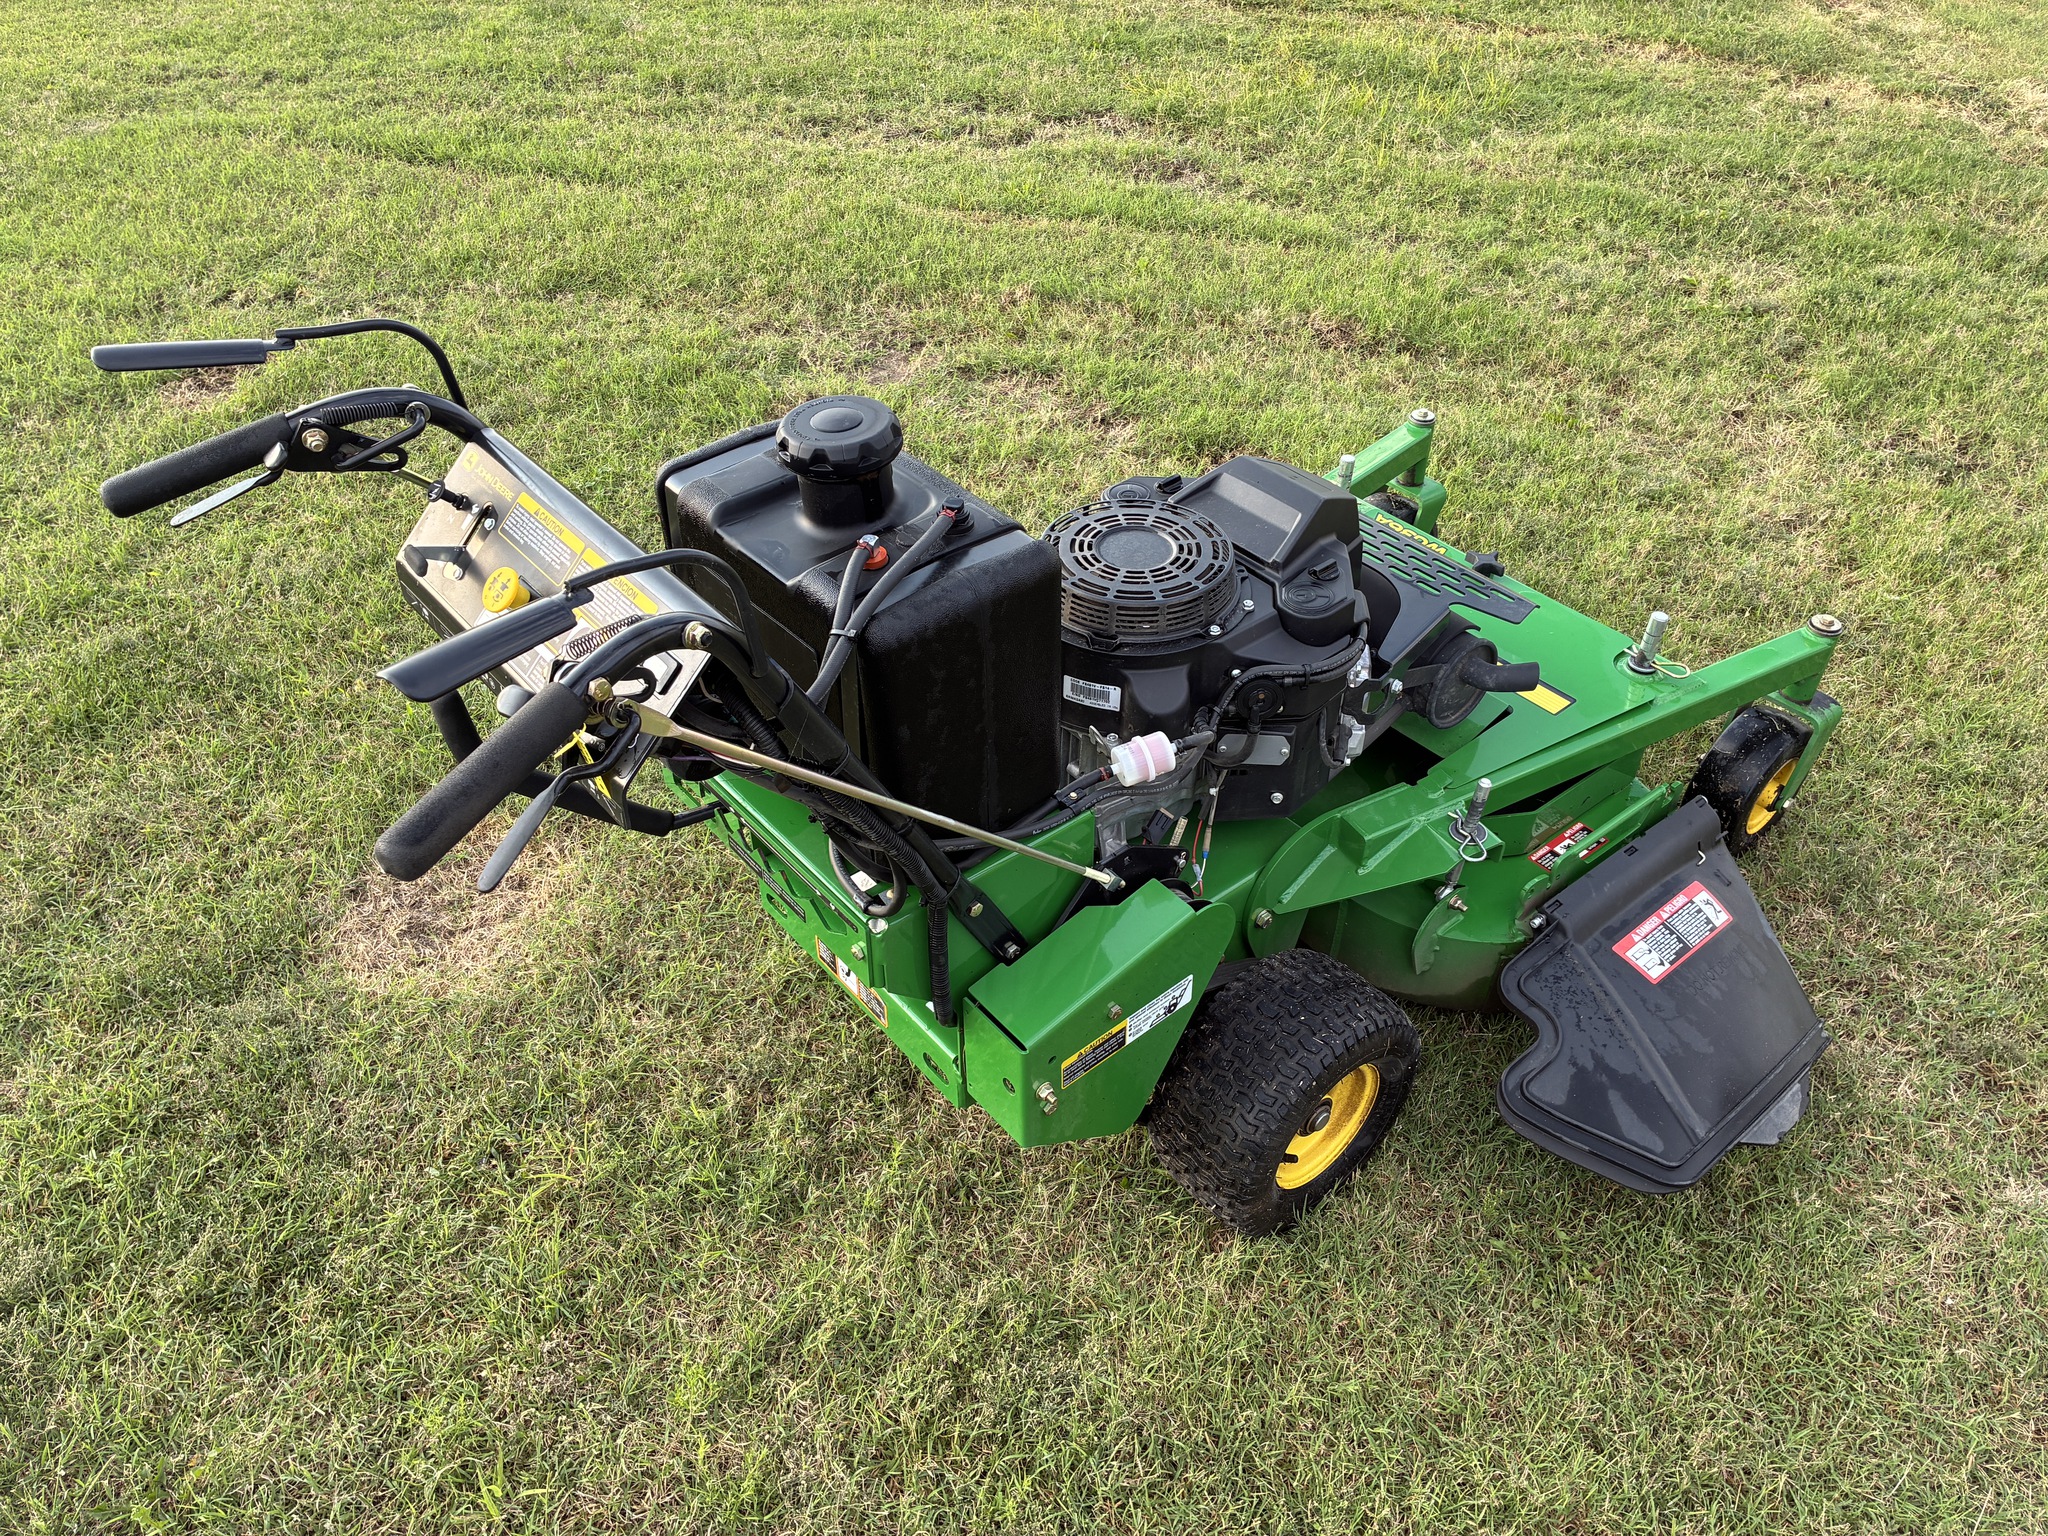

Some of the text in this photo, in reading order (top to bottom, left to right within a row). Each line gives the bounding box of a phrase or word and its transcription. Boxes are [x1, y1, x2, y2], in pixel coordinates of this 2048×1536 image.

[474, 463, 494, 483] JOHN
[491, 477, 515, 502] DEERE
[538, 511, 565, 537] CAUTION
[1635, 914, 1662, 938] DANGER
[1662, 893, 1689, 915] PELIGRO
[1084, 1030, 1114, 1052] CAUTION
